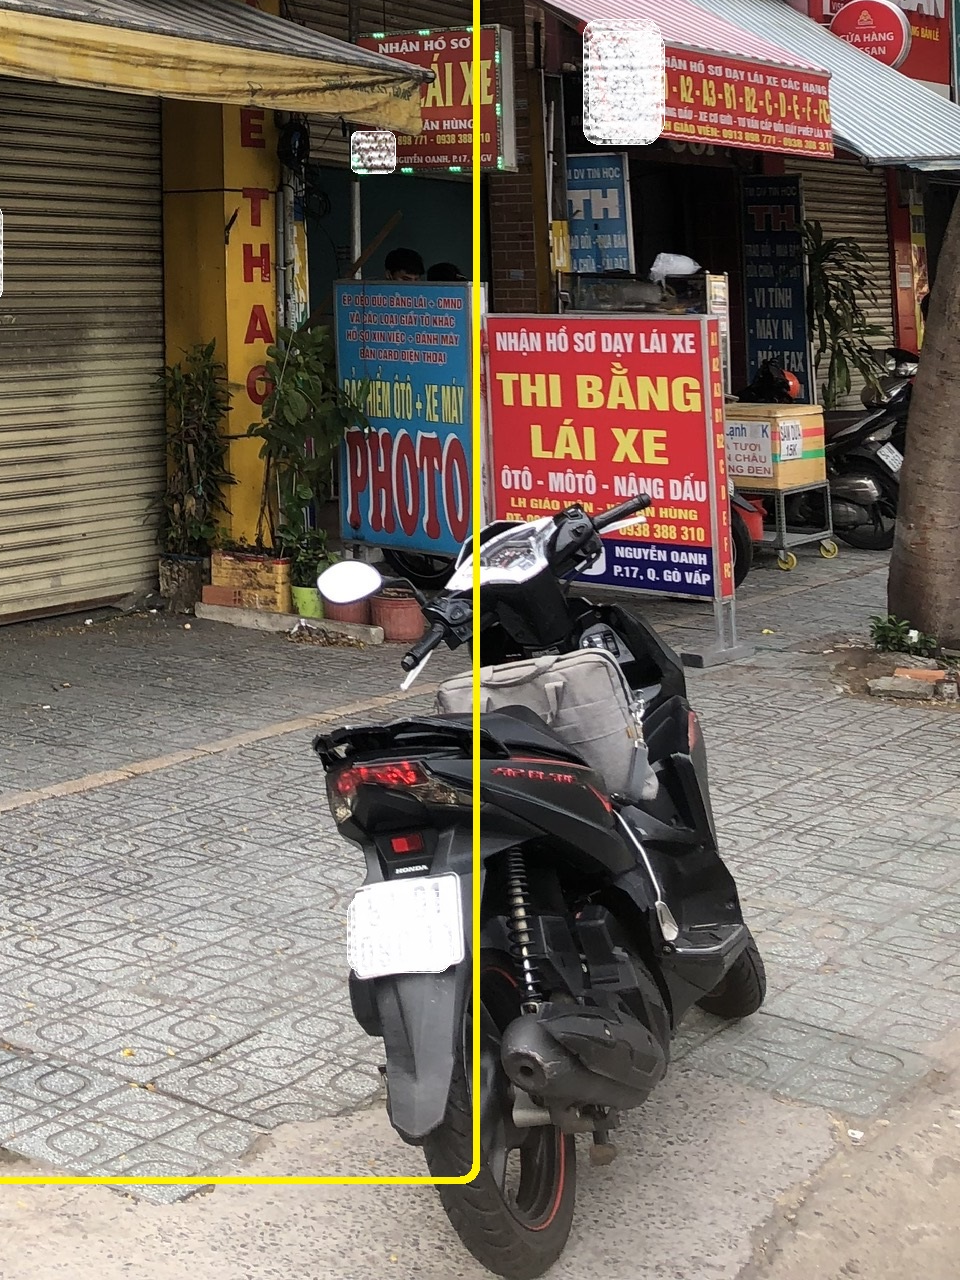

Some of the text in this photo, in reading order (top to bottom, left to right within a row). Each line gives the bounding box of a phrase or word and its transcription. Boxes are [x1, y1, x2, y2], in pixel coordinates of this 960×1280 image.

[378, 39, 420, 55] NHẬN
[863, 31, 895, 42] HÀNG
[421, 53, 454, 108] ÁI
[765, 75, 780, 87] XE
[780, 77, 801, 91] CÁC
[679, 74, 695, 104] A2
[702, 78, 717, 108] A3
[743, 86, 759, 114] B2
[764, 89, 773, 116] C
[778, 91, 787, 118] D
[792, 94, 800, 121] E
[806, 96, 812, 122] F
[566, 188, 622, 220] TH
[747, 204, 797, 232] TH
[495, 325, 697, 358] NHẬN HỒ SƠ DẠY LÁI XE
[495, 360, 702, 413] THI BẰNG
[424, 382, 439, 423] XE
[441, 377, 464, 425] MÁY
[529, 418, 670, 466] LÁI XE
[726, 423, 769, 440] ạnh K
[735, 452, 767, 464] CHÂU
[747, 465, 771, 475] ĐEN
[343, 426, 470, 544] PHOTO
[501, 464, 707, 503] ÔTÔ MÔTÔ NÂNG DẤU
[510, 495, 699, 521] LH GIÁO HÙNG
[652, 523, 678, 541] 388
[680, 525, 706, 543] 310
[614, 543, 708, 566] NGUYỄN OANH
[612, 564, 712, 586] P.17, Q. GÒ VẤP
[394, 864, 429, 875] HONDA
